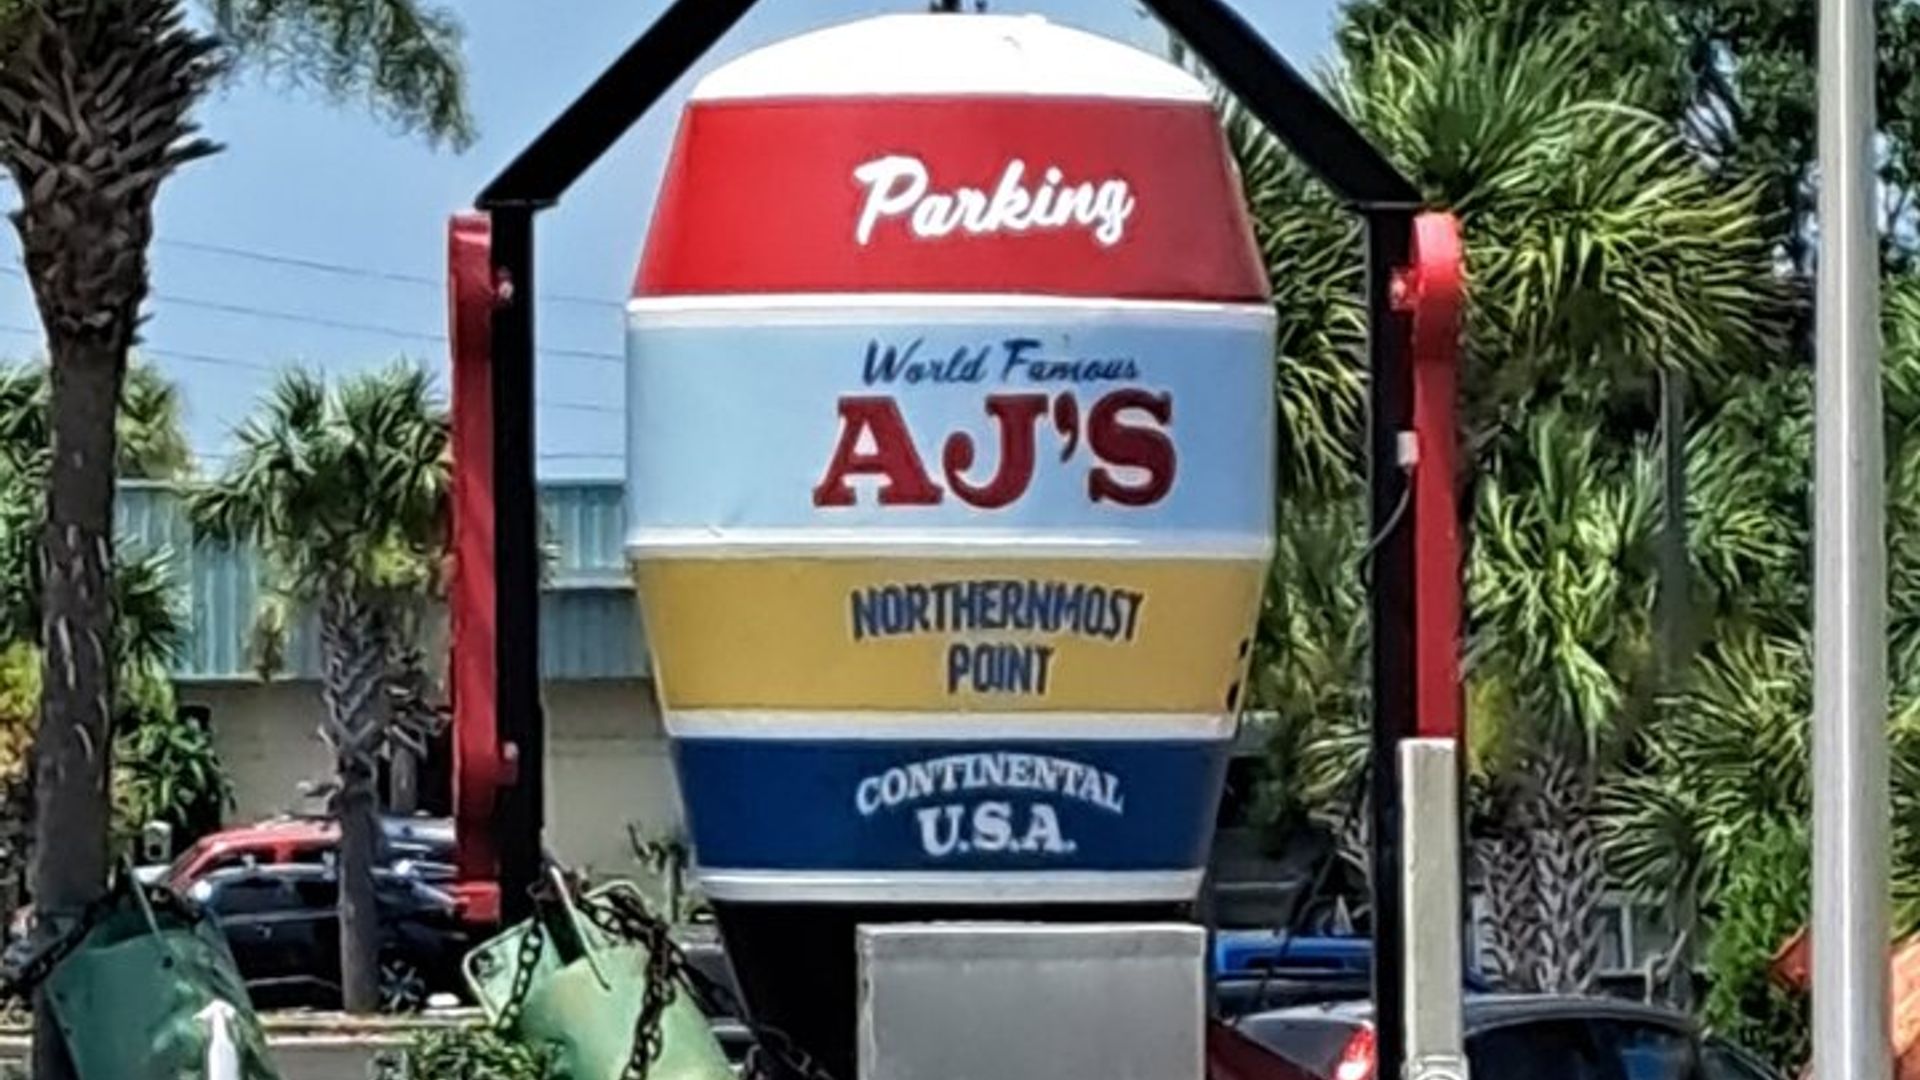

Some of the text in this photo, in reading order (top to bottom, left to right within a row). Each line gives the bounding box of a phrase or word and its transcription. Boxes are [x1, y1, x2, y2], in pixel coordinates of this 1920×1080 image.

[853, 155, 1134, 245] Parking
[862, 337, 1139, 385] World Famous
[812, 388, 1177, 509] AJ'S
[850, 580, 1145, 641] NORTHERNMOST
[947, 642, 1056, 695] POINT
[856, 751, 1124, 815] CONTINENTAL
[917, 803, 1080, 855] U.S.A.
